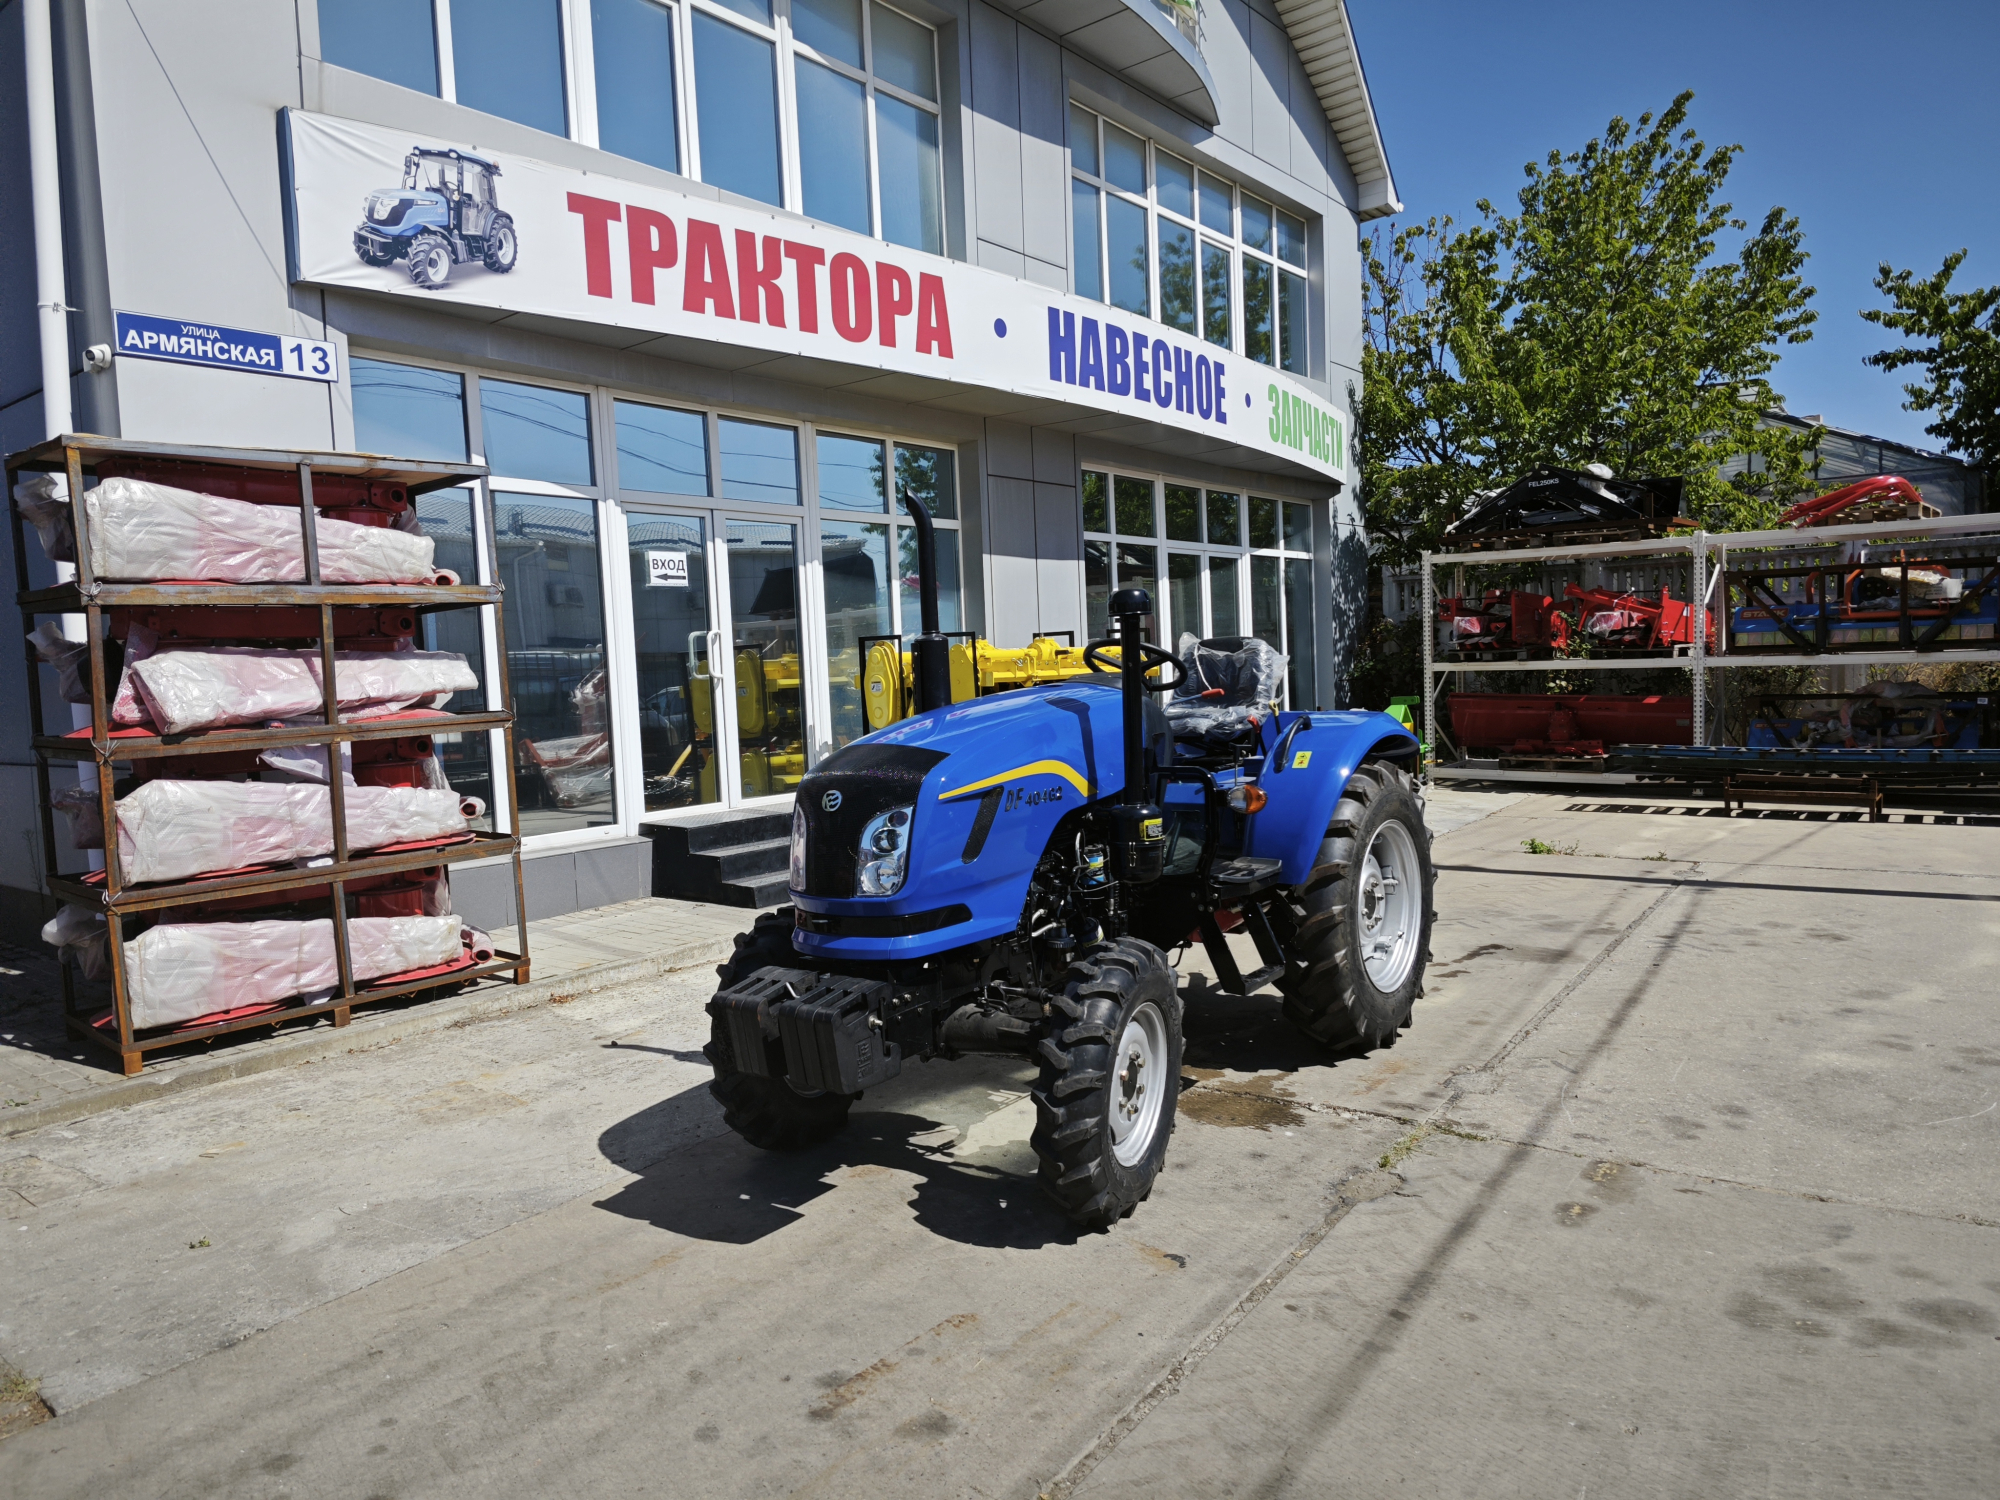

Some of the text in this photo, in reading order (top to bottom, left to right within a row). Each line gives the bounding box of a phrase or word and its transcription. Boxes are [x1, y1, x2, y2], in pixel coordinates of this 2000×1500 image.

[181, 324, 220, 340] УЛИЦА
[566, 191, 1343, 471] ТРАКТОРА НАВЕСНОЕ ЗАПЧАСТИ
[124, 329, 330, 375] АРМЯНСКАЯ 13
[1528, 478, 1559, 488] FEL250KS
[652, 558, 685, 573] ВХОД
[1742, 609, 1787, 619] STAK
[1004, 786, 1062, 812] DF 404G2
